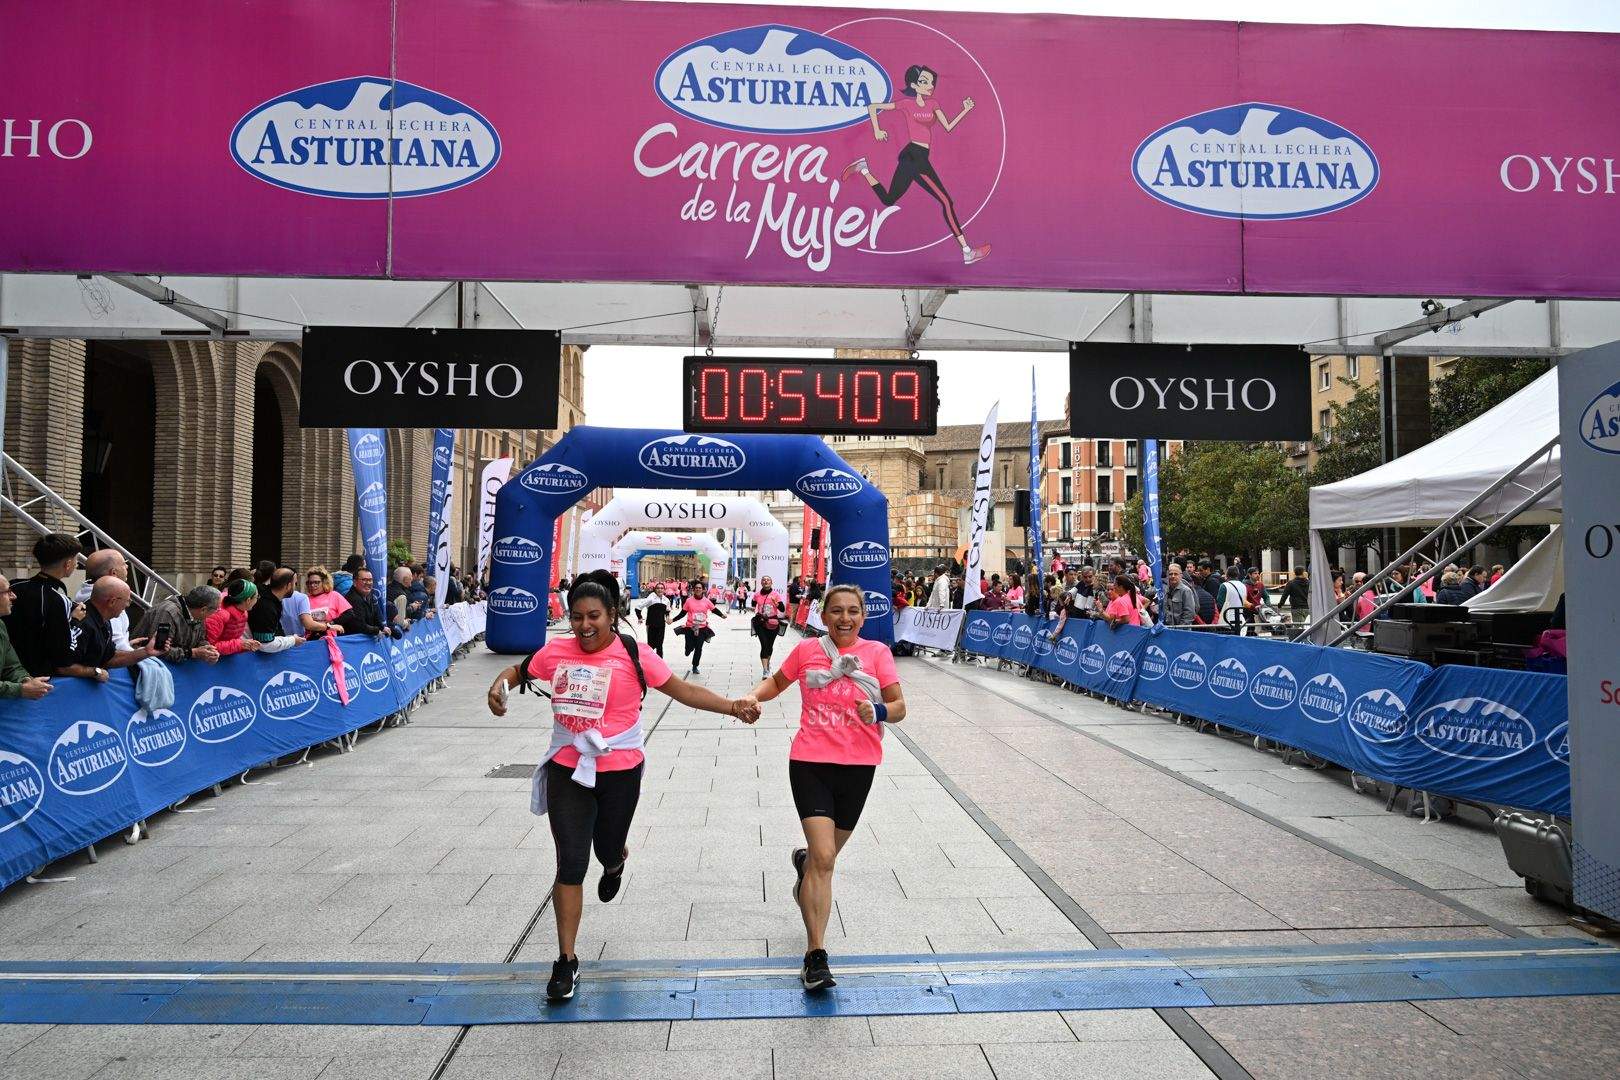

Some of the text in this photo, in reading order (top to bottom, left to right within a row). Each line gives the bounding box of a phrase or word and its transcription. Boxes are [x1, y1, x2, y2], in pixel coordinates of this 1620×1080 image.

[710, 60, 867, 76] CENTRAL LECHERA
[673, 62, 872, 108] ASTURIANA
[294, 118, 472, 132] CENTRAL LECHERA
[251, 120, 480, 168] ASTURIANA
[633, 122, 828, 183] Carrera
[1190, 142, 1352, 155] CENTRAL LECHERA
[1151, 144, 1361, 190] ASTURIANA
[680, 180, 901, 272] de la Mujer
[343, 359, 523, 398] OYSHO
[1109, 376, 1277, 412] OYSHO
[647, 447, 737, 468] ASTURIANA
[523, 473, 582, 488] ASTURIANA
[801, 481, 858, 492] ASTURIANA
[644, 502, 727, 519] OYSHO
[494, 549, 539, 559] ASTURIANA
[841, 551, 887, 563] ASTURIANA
[866, 603, 888, 612] RIANA
[913, 610, 951, 631] OYSHO
[1171, 663, 1203, 682] ASTURIANA
[1210, 669, 1244, 691] ASTURIANA
[266, 688, 317, 713] ASTURIANA
[1252, 678, 1294, 701] ASTURIANA
[195, 705, 254, 735] ASTURIANA
[131, 727, 183, 757] ASTURIANA
[1421, 715, 1525, 750] ASTURIANA
[65, 744, 92, 758] CENTRAL
[58, 745, 126, 786] ASTURIANA
